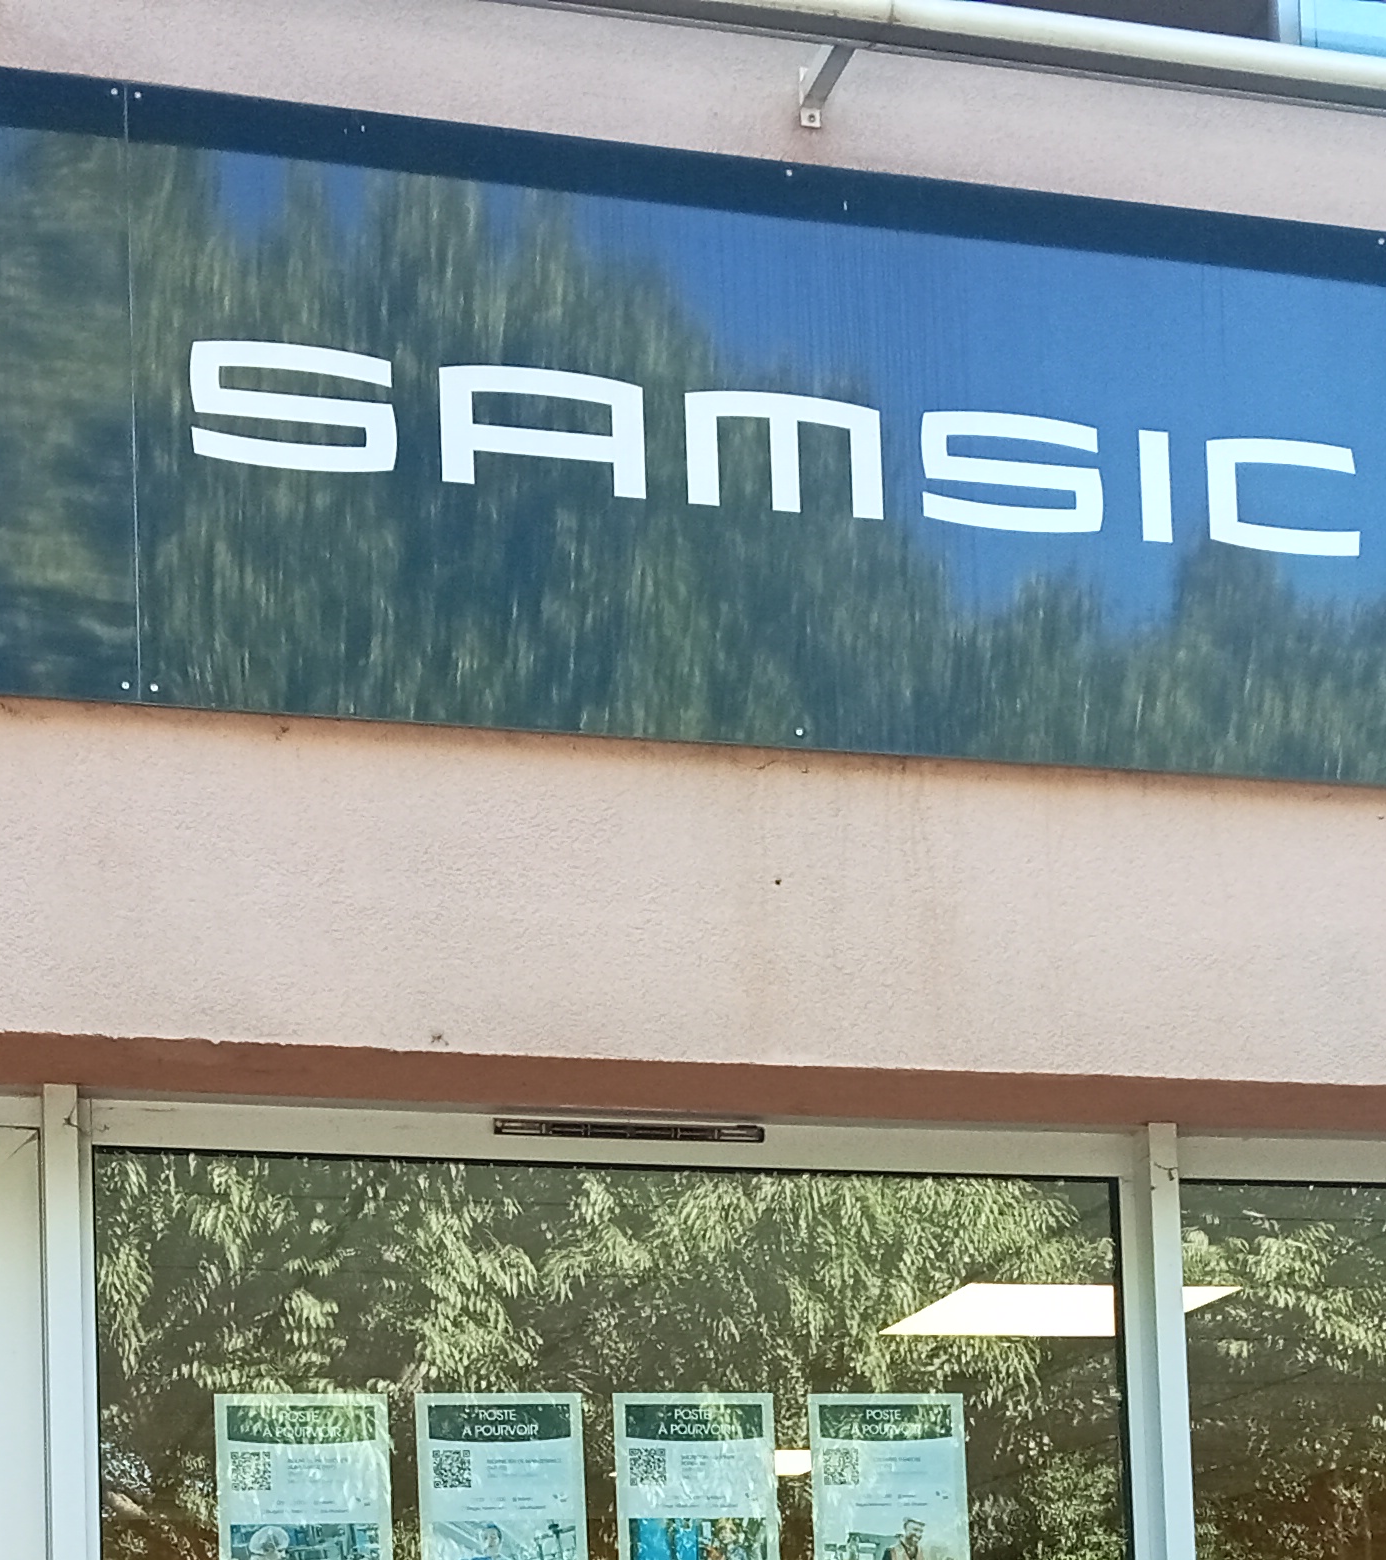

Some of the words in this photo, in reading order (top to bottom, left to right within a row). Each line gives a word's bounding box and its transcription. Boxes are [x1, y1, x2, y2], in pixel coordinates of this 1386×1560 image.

[189, 339, 1361, 558] SAMSIC
[478, 1409, 517, 1421] POSTE
[674, 1408, 711, 1420] POSTE
[866, 1409, 902, 1421] POSTE
[475, 1424, 540, 1438] POURVOIR
